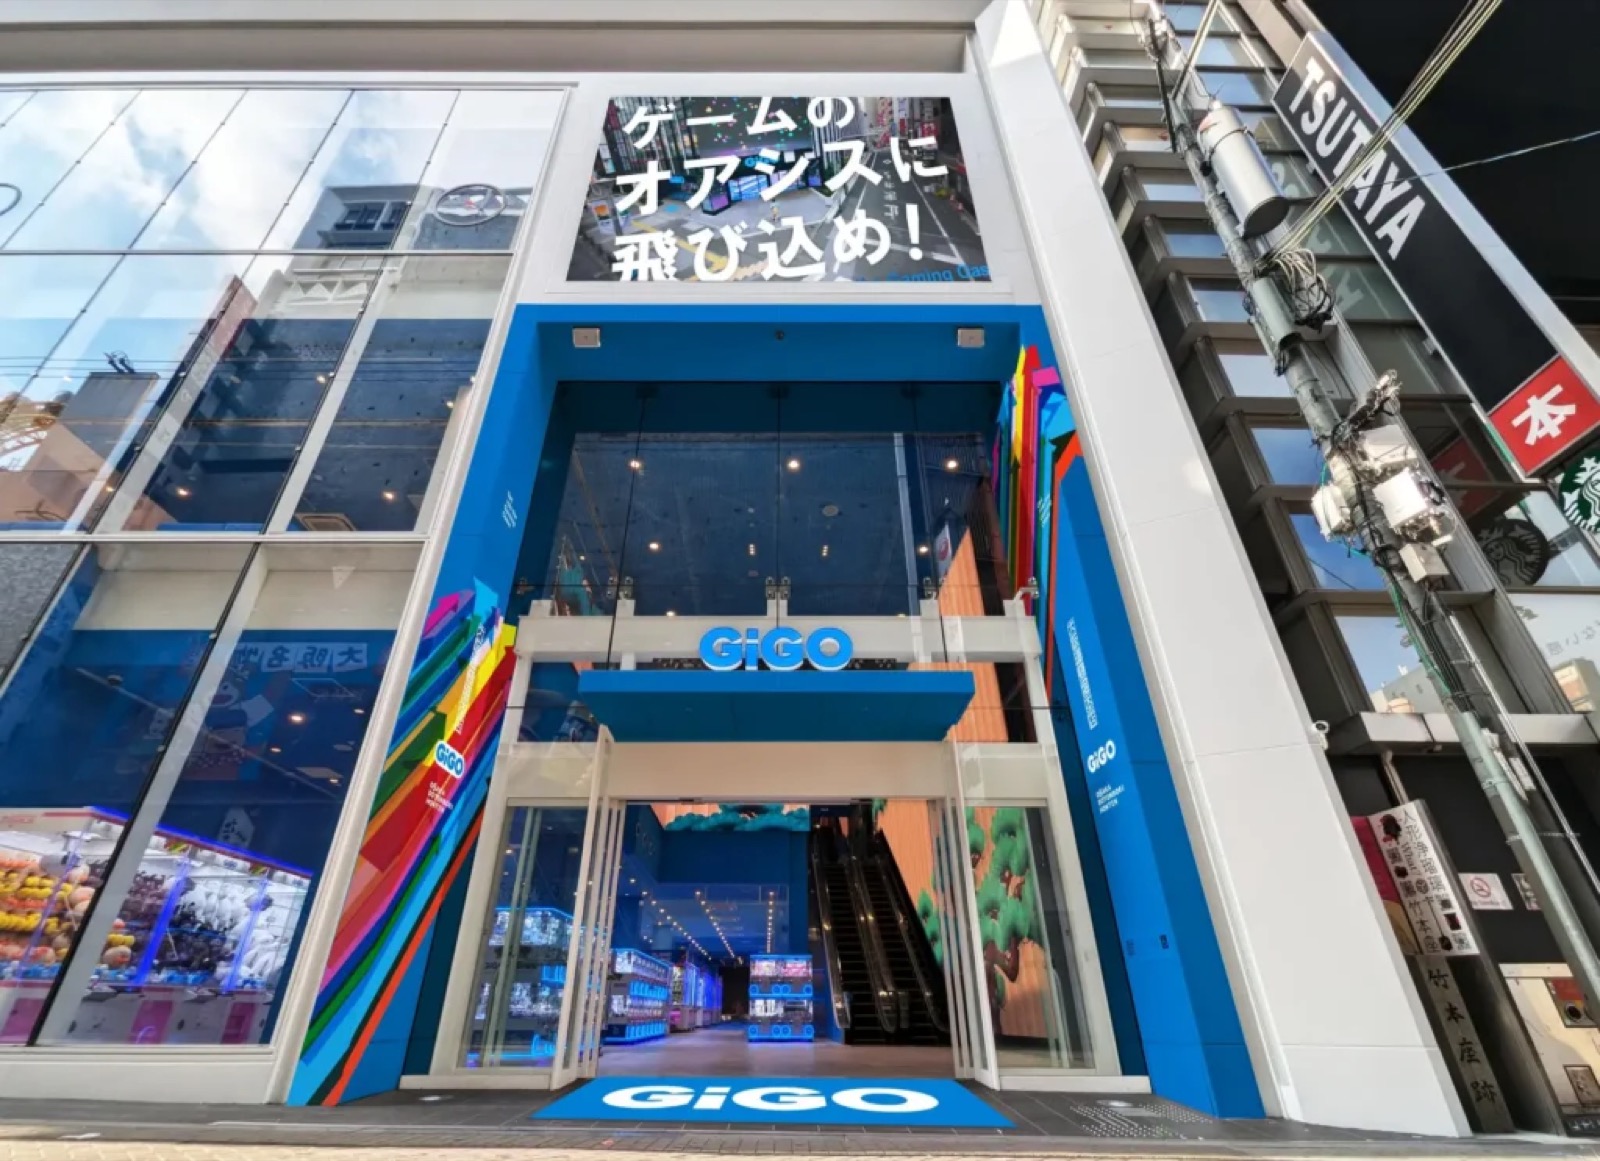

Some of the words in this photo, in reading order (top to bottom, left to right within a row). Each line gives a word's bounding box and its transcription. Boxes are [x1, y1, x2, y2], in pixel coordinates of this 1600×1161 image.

[623, 96, 856, 149] ゲームの
[616, 136, 949, 215] オアシスに
[1288, 57, 1426, 261] TSUTAYA
[1511, 384, 1576, 446] 本
[698, 626, 854, 671] GiGO
[436, 742, 464, 777] GiGO
[1087, 739, 1116, 774] GiGO
[1427, 968, 1497, 1104] 竹本座跡
[602, 1085, 940, 1113] GiGO
